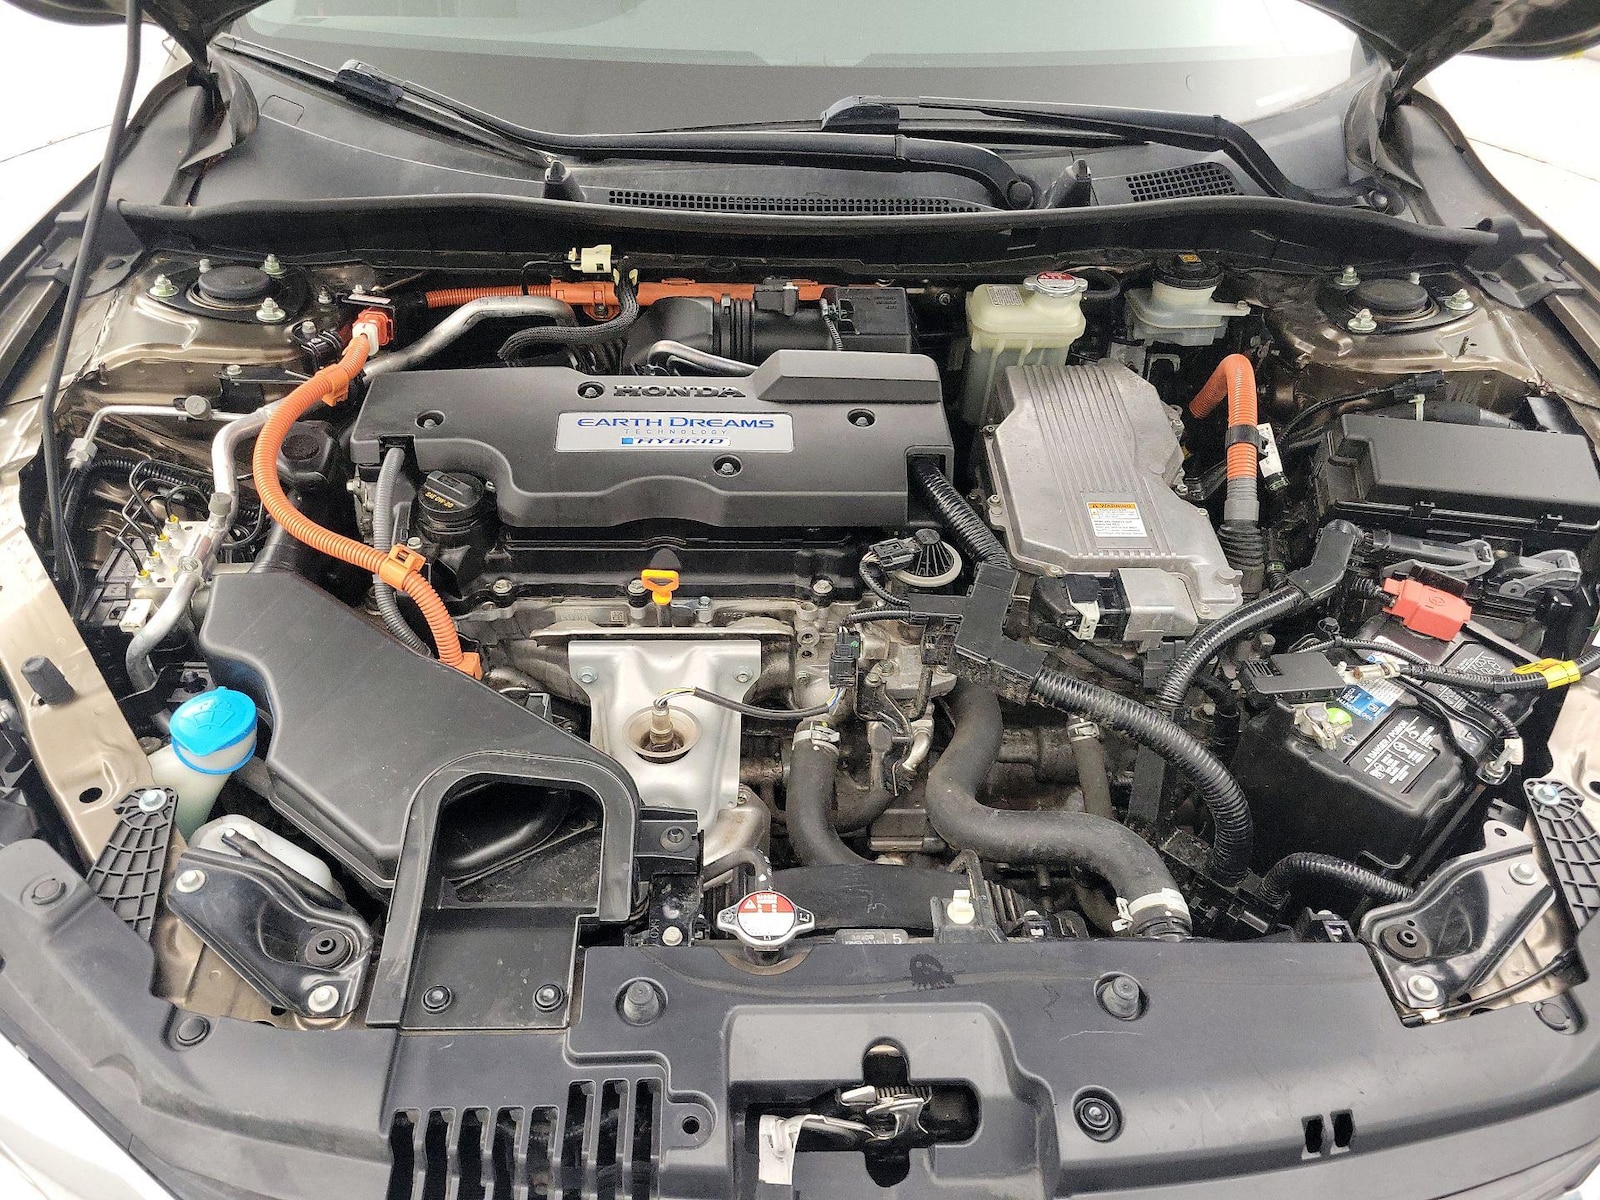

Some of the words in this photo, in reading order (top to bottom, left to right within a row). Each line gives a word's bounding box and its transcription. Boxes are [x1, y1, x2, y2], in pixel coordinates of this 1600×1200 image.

[613, 385, 746, 398] HONDA
[577, 417, 663, 428] EARTH
[669, 416, 775, 429] DREAMS
[637, 437, 724, 445] HYBRID
[425, 491, 437, 500] SAE
[1367, 738, 1390, 759] DANGER
